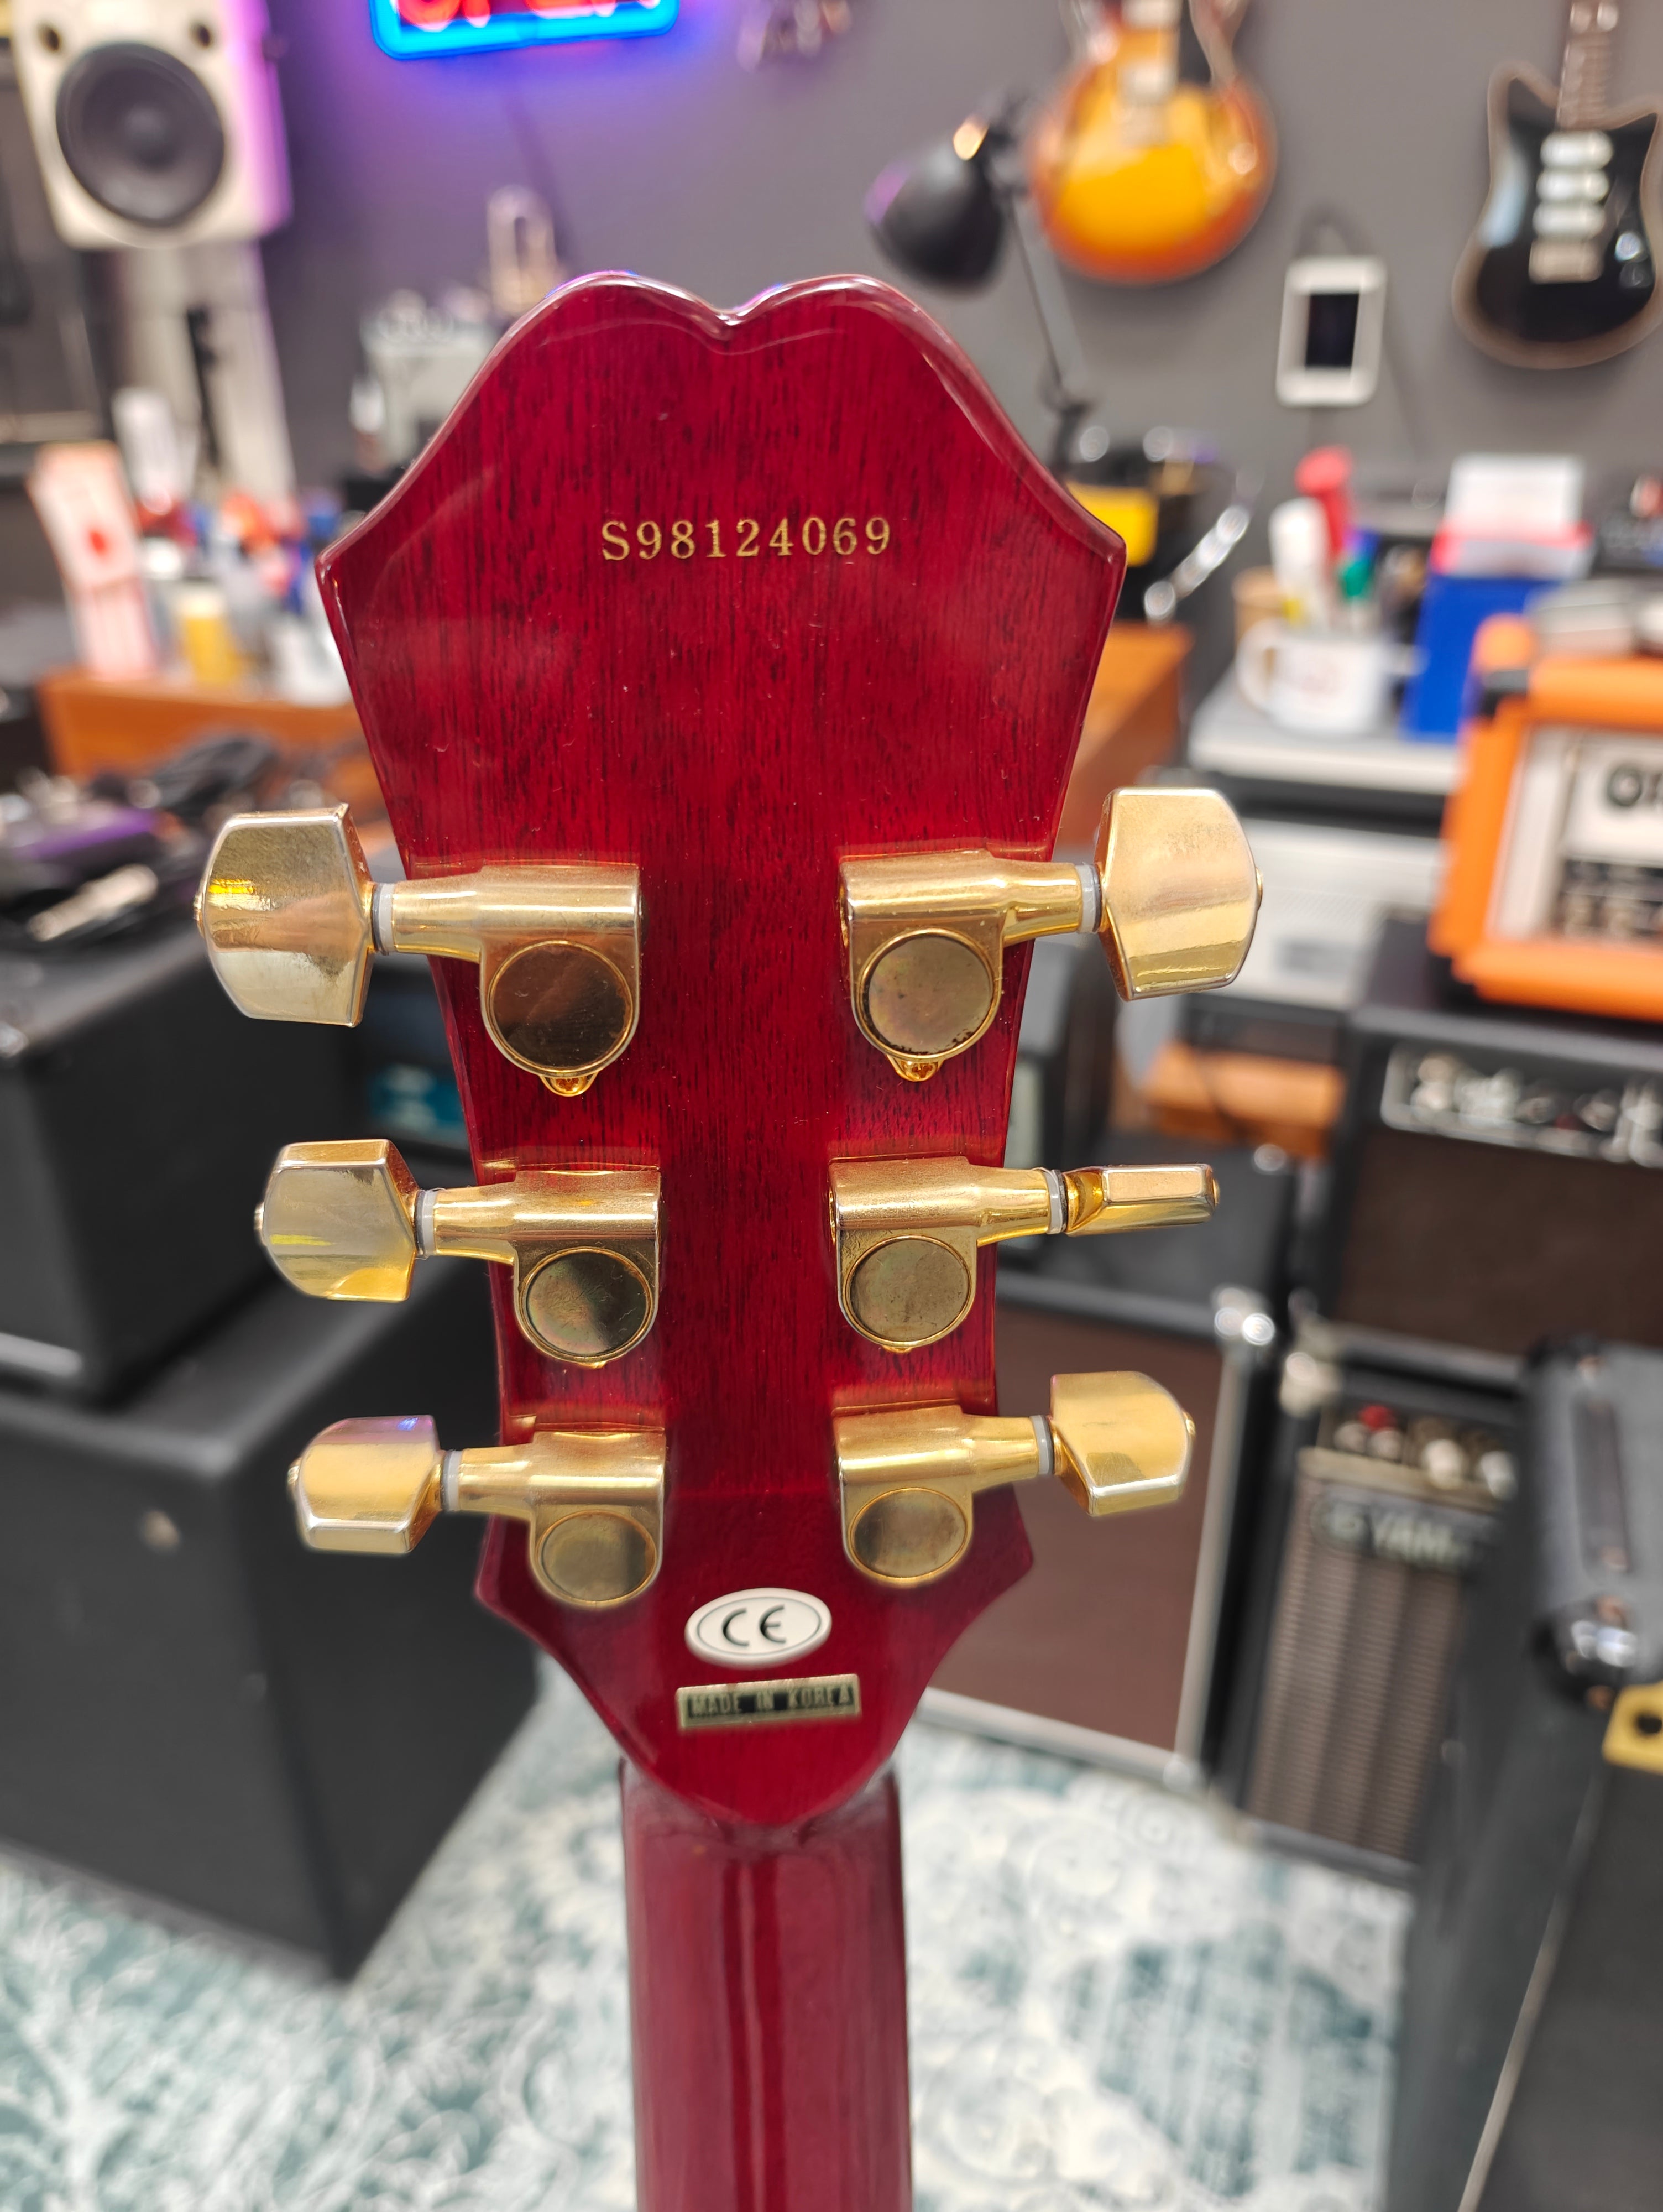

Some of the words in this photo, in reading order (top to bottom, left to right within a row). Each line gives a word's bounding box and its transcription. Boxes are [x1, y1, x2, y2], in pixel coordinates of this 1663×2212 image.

[602, 517, 890, 561] S98124069
[721, 1604, 787, 1647] CE
[691, 1693, 741, 1715] MADE
[757, 1689, 773, 1710] IN
[787, 1684, 851, 1708] KOREA
